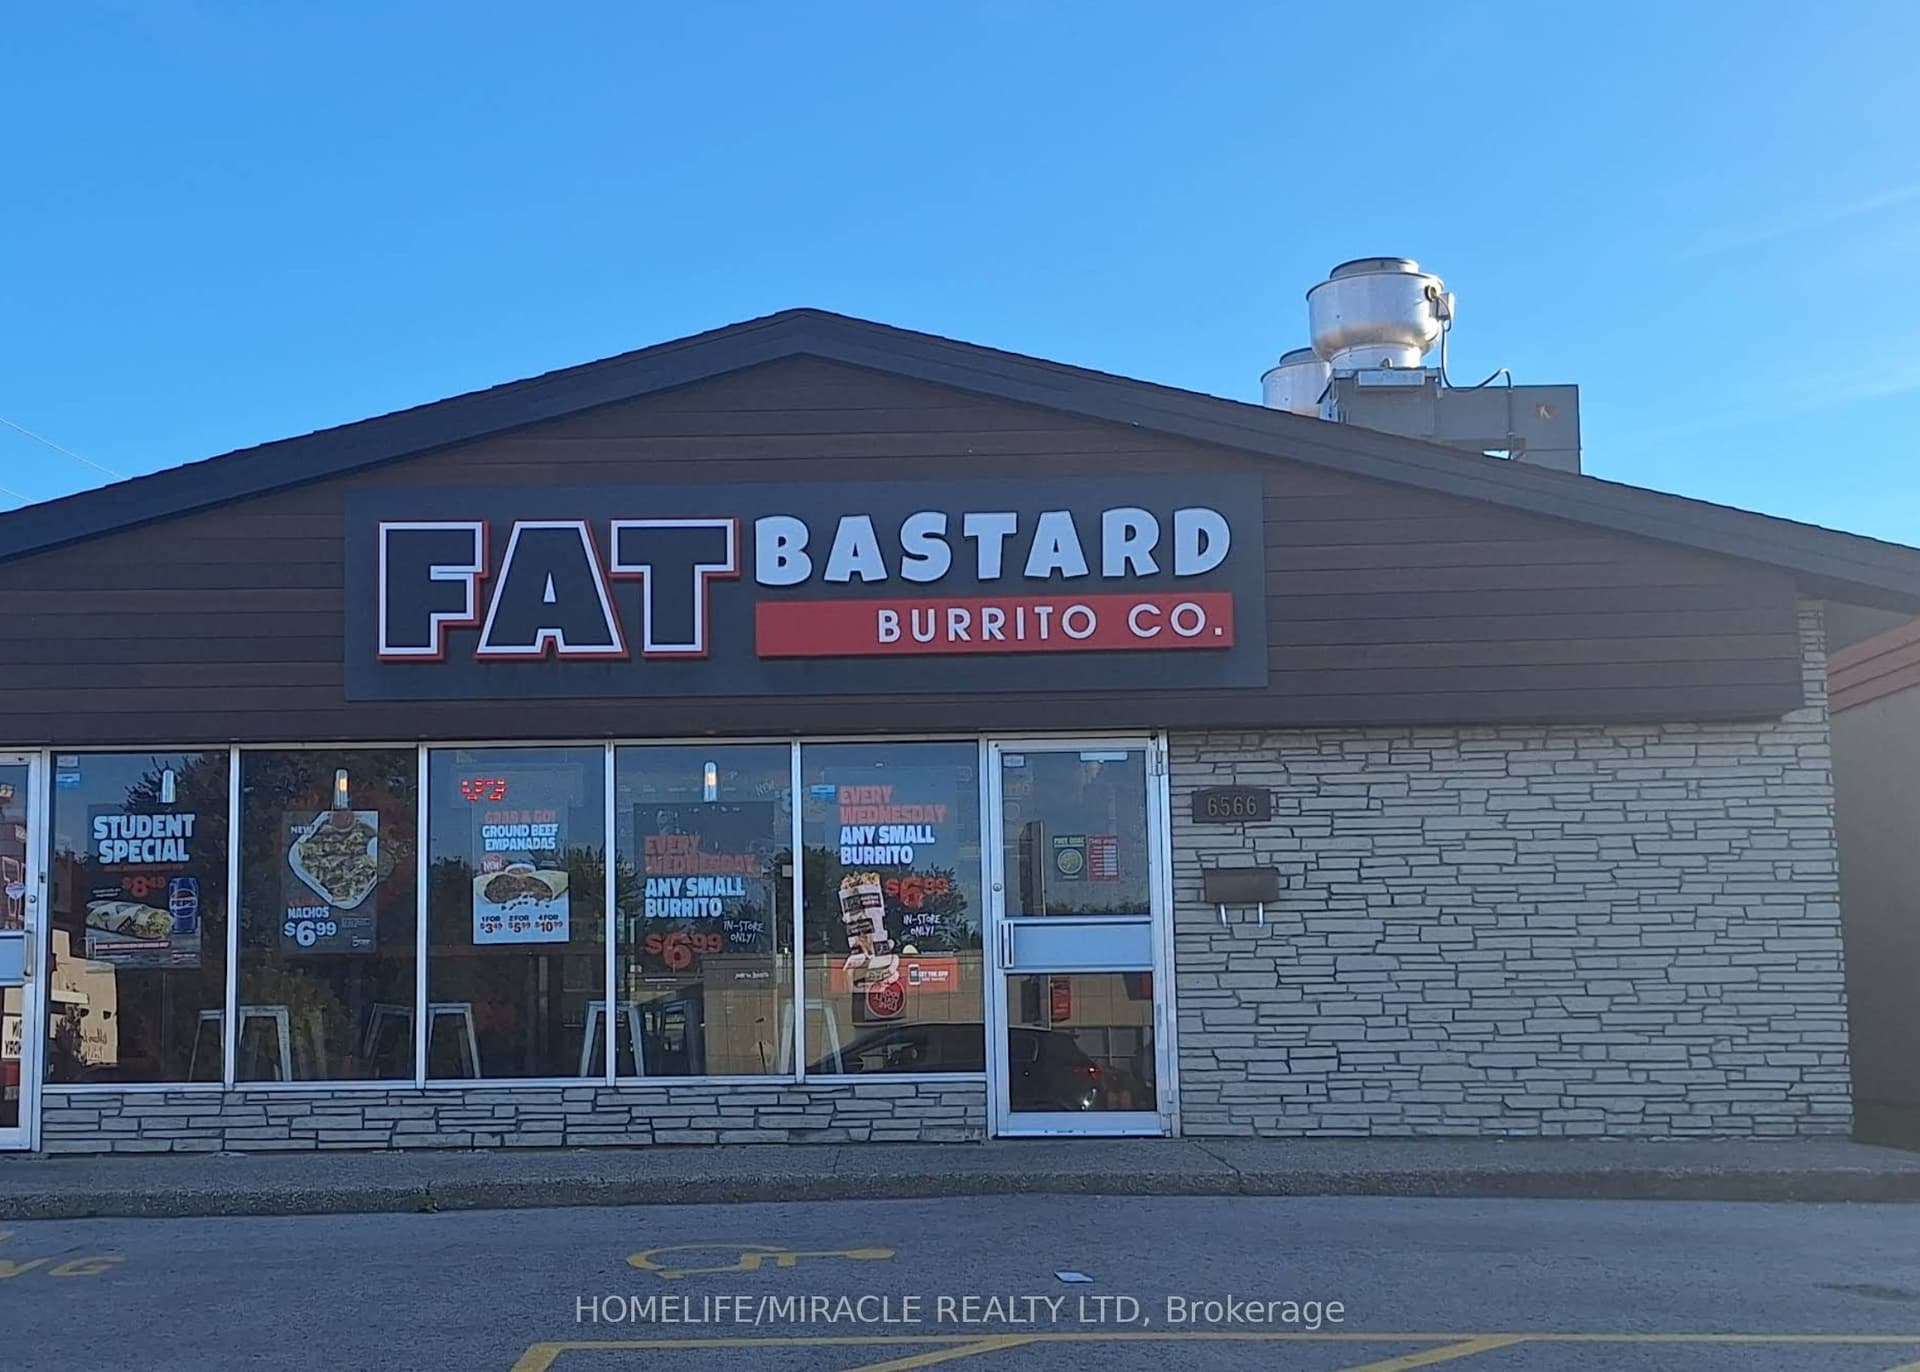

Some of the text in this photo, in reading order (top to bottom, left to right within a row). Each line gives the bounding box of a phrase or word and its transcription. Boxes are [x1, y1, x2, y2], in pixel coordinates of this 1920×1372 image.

[377, 507, 1231, 658] FAT BASTARD
[878, 602, 1223, 643] BURRITO CO.
[839, 785, 894, 803] EVERY
[839, 804, 946, 824] WEDNESDAY
[1207, 796, 1258, 816] 6566
[93, 814, 195, 839] STUDENT
[482, 824, 558, 838] GROUND BEEF
[840, 825, 935, 845] ANY SMALL
[99, 838, 190, 864] SPECIAL
[485, 837, 556, 851] EMPANADAS
[645, 835, 700, 853] EVERY
[840, 846, 914, 864] BURRITO
[645, 877, 746, 897] ANY SMALL
[288, 907, 329, 919] NACHOS
[645, 897, 722, 917] BURRITO
